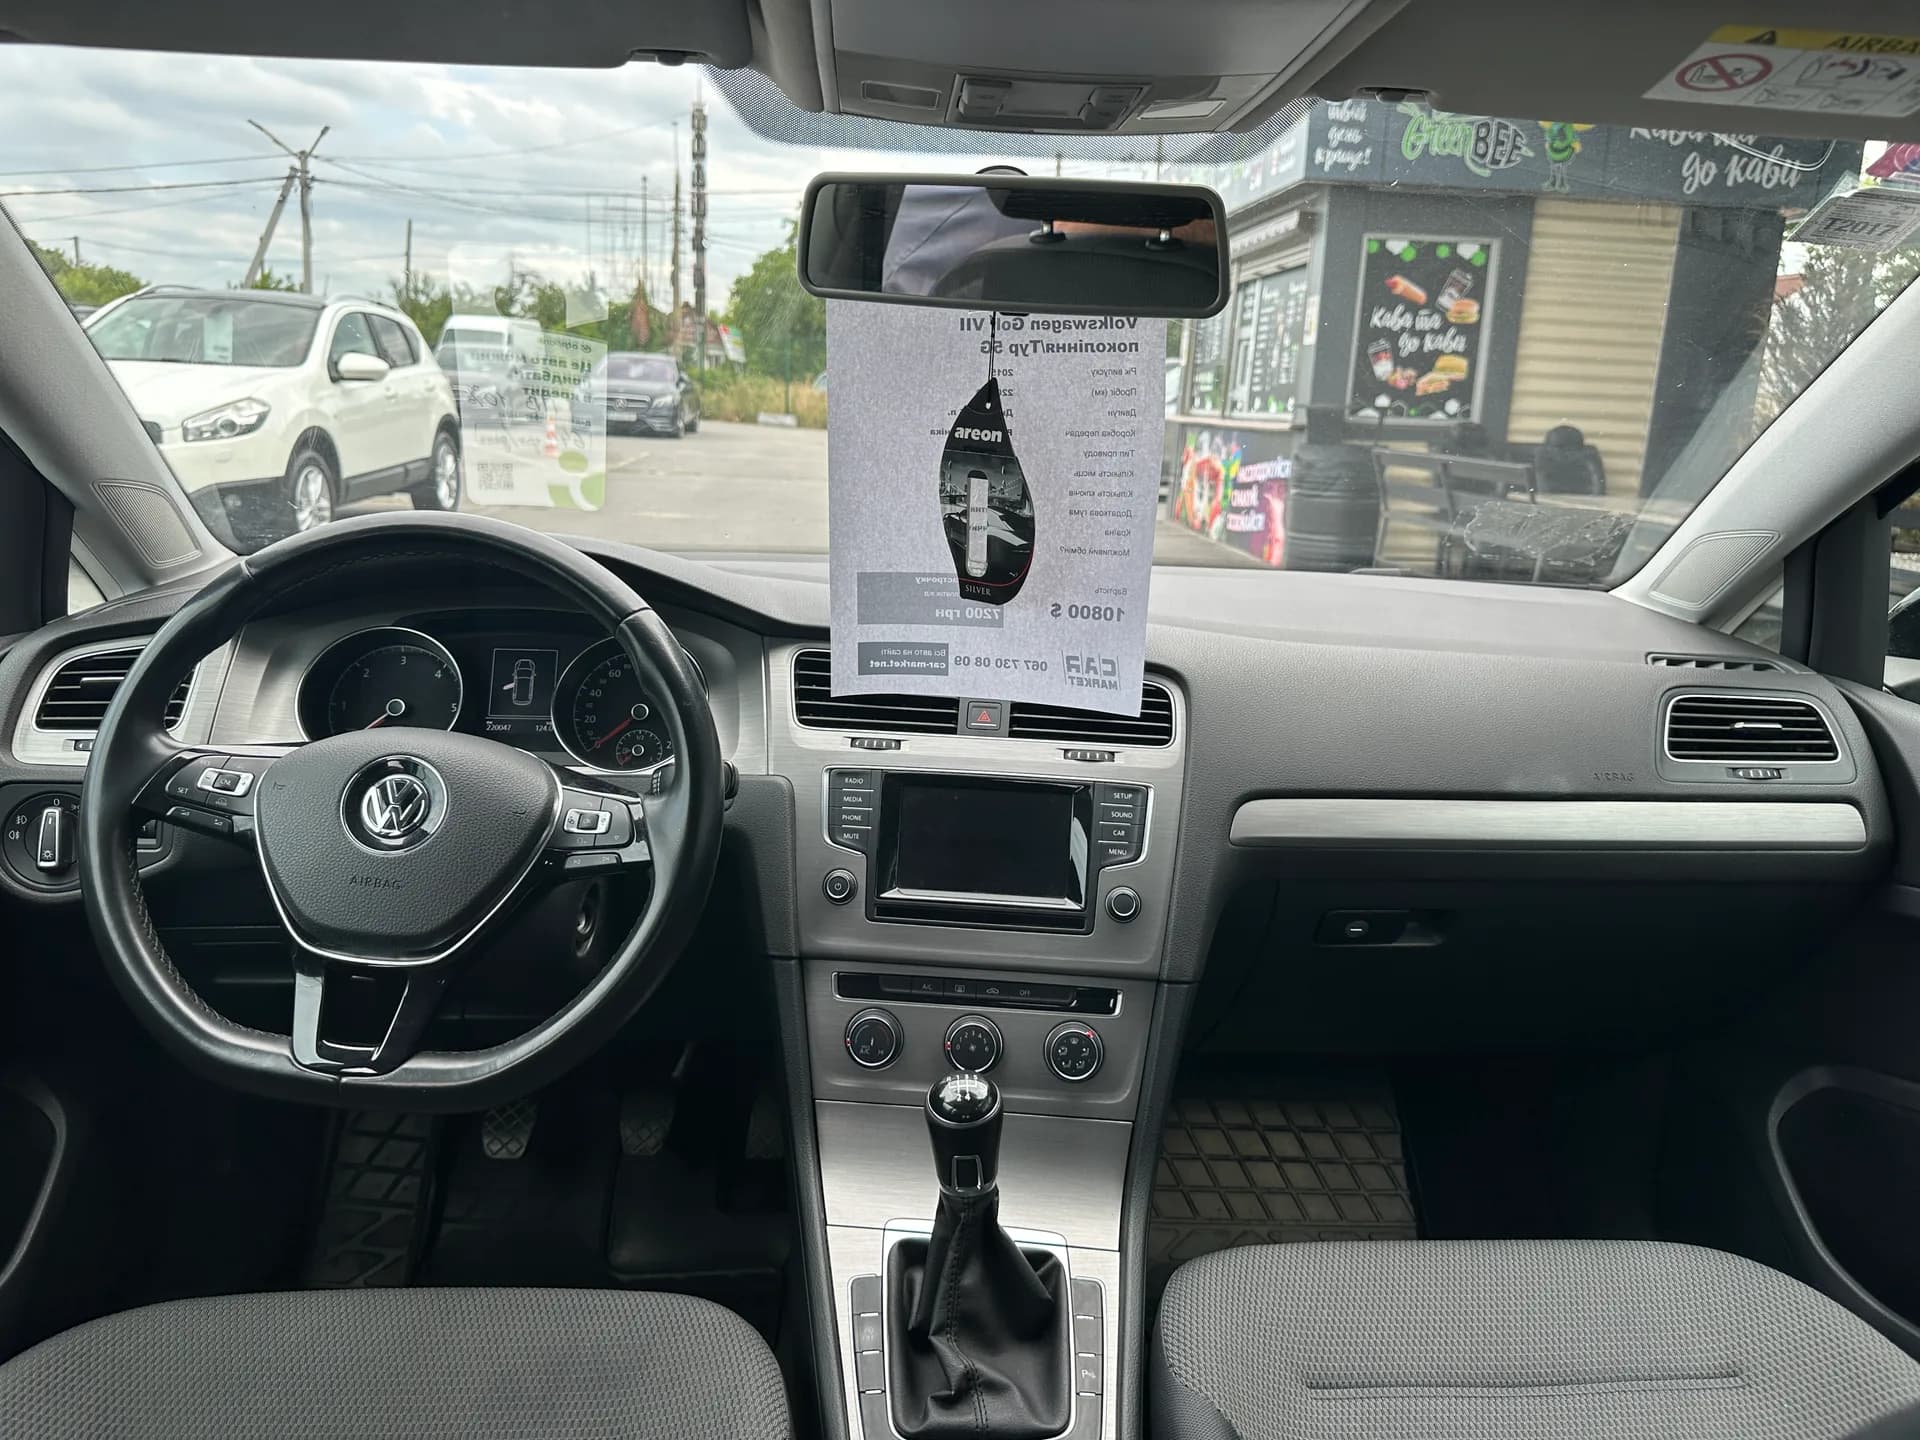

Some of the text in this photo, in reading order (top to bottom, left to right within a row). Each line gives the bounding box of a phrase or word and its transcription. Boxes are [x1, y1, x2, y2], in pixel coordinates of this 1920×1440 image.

[1827, 34, 1920, 55] AIRBA
[1369, 303, 1414, 332] Кава
[954, 426, 1003, 443] areon
[965, 584, 992, 597] SILVER
[401, 656, 407, 665] 3
[363, 668, 370, 678] 2
[434, 670, 442, 678] 4
[608, 669, 621, 678] 60
[590, 689, 602, 697] 40
[451, 703, 457, 712] 5
[584, 715, 596, 723] 20
[176, 786, 189, 795] SET
[349, 875, 401, 890] AIRBAG
